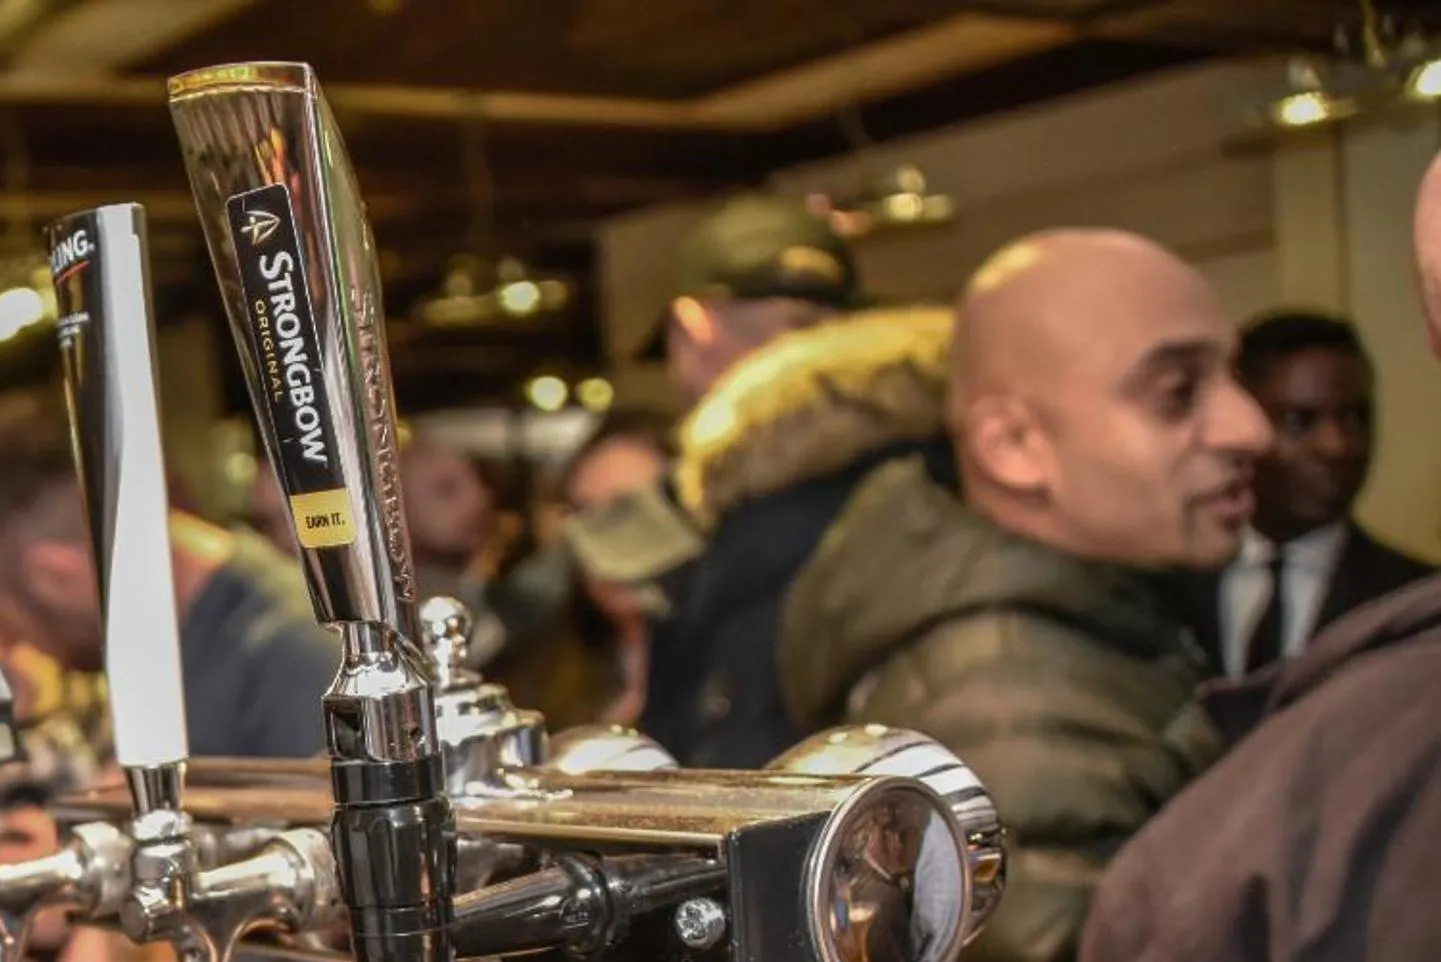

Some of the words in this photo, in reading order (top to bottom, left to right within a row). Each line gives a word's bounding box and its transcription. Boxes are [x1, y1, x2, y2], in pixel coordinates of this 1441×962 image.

[255, 299, 283, 402] ORIGINAL
[260, 250, 328, 467] STRONGBOW
[305, 513, 330, 529] EARN
